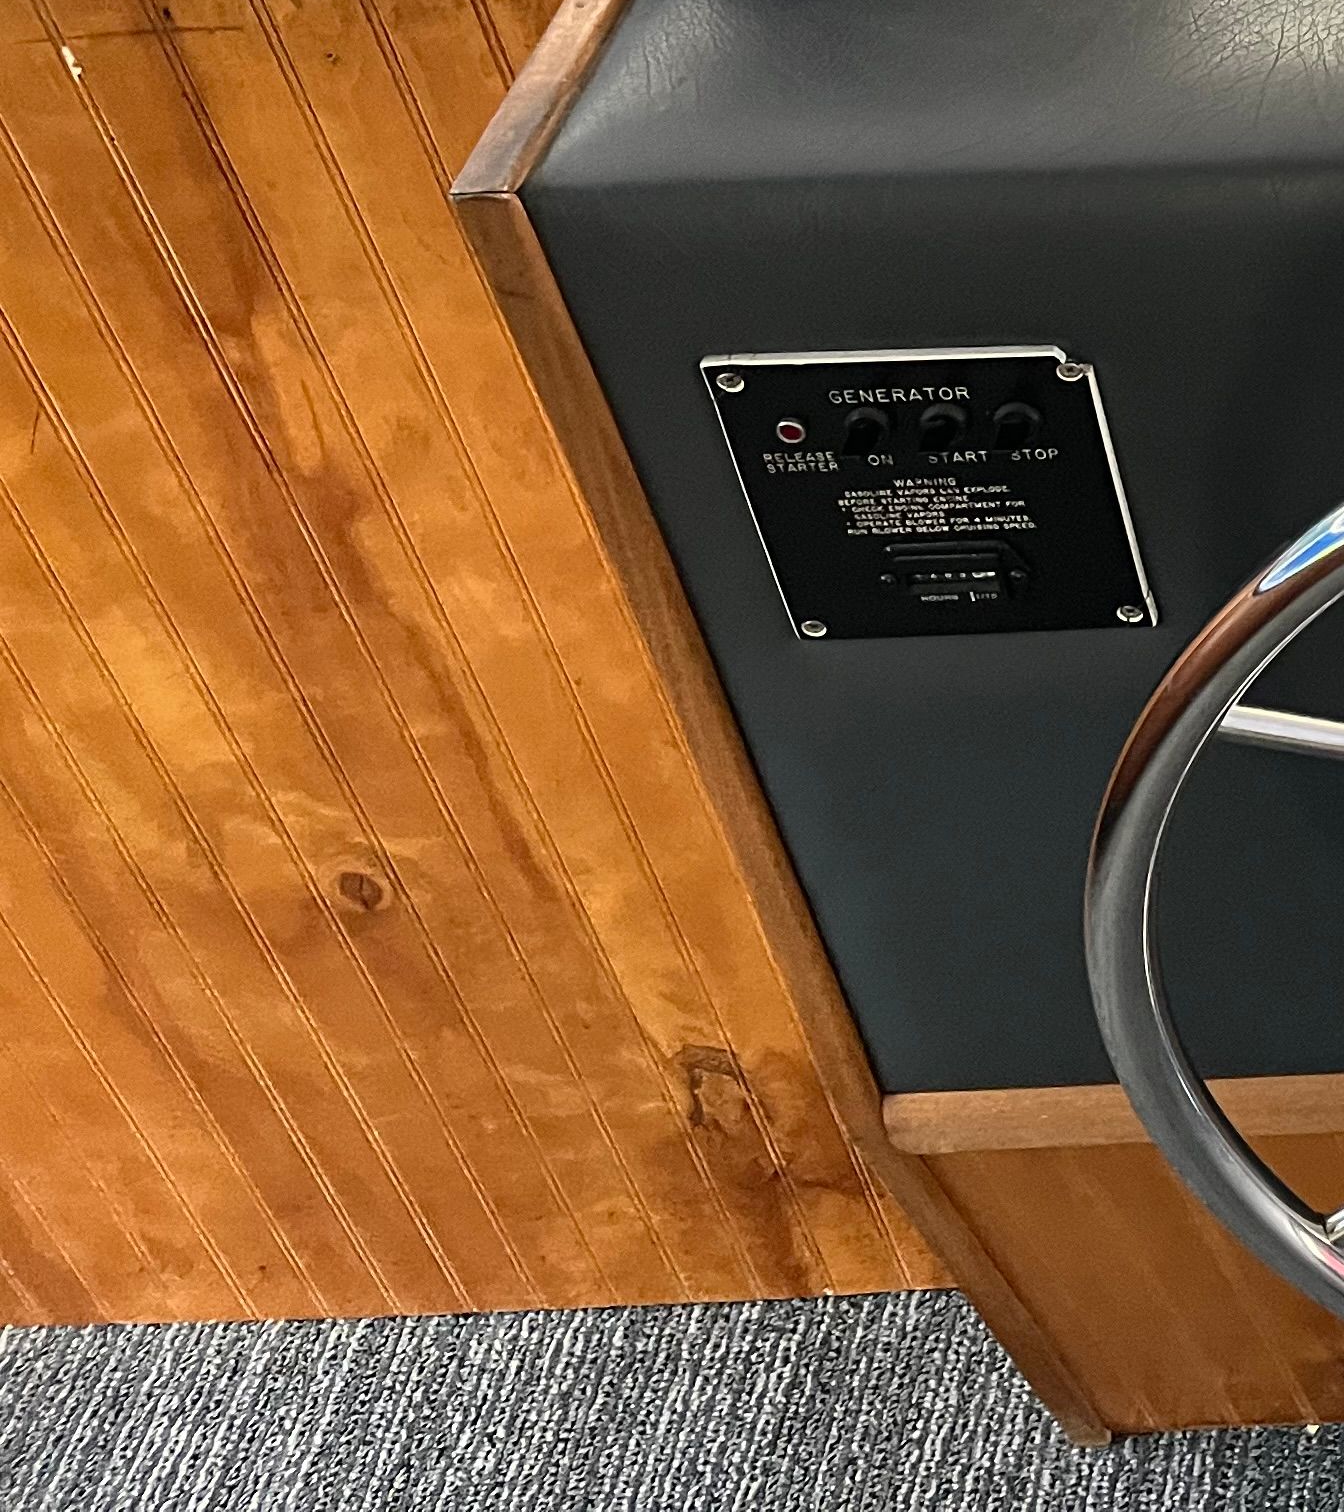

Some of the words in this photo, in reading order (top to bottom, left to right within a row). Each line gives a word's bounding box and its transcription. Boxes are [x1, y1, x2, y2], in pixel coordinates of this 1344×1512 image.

[828, 387, 970, 405] GENERATOR
[763, 451, 835, 464] RELEASE
[867, 454, 894, 466] ON
[928, 451, 988, 464] START
[1011, 448, 1058, 460] STOP
[767, 462, 839, 473] STARTER
[893, 477, 956, 487] WARNING
